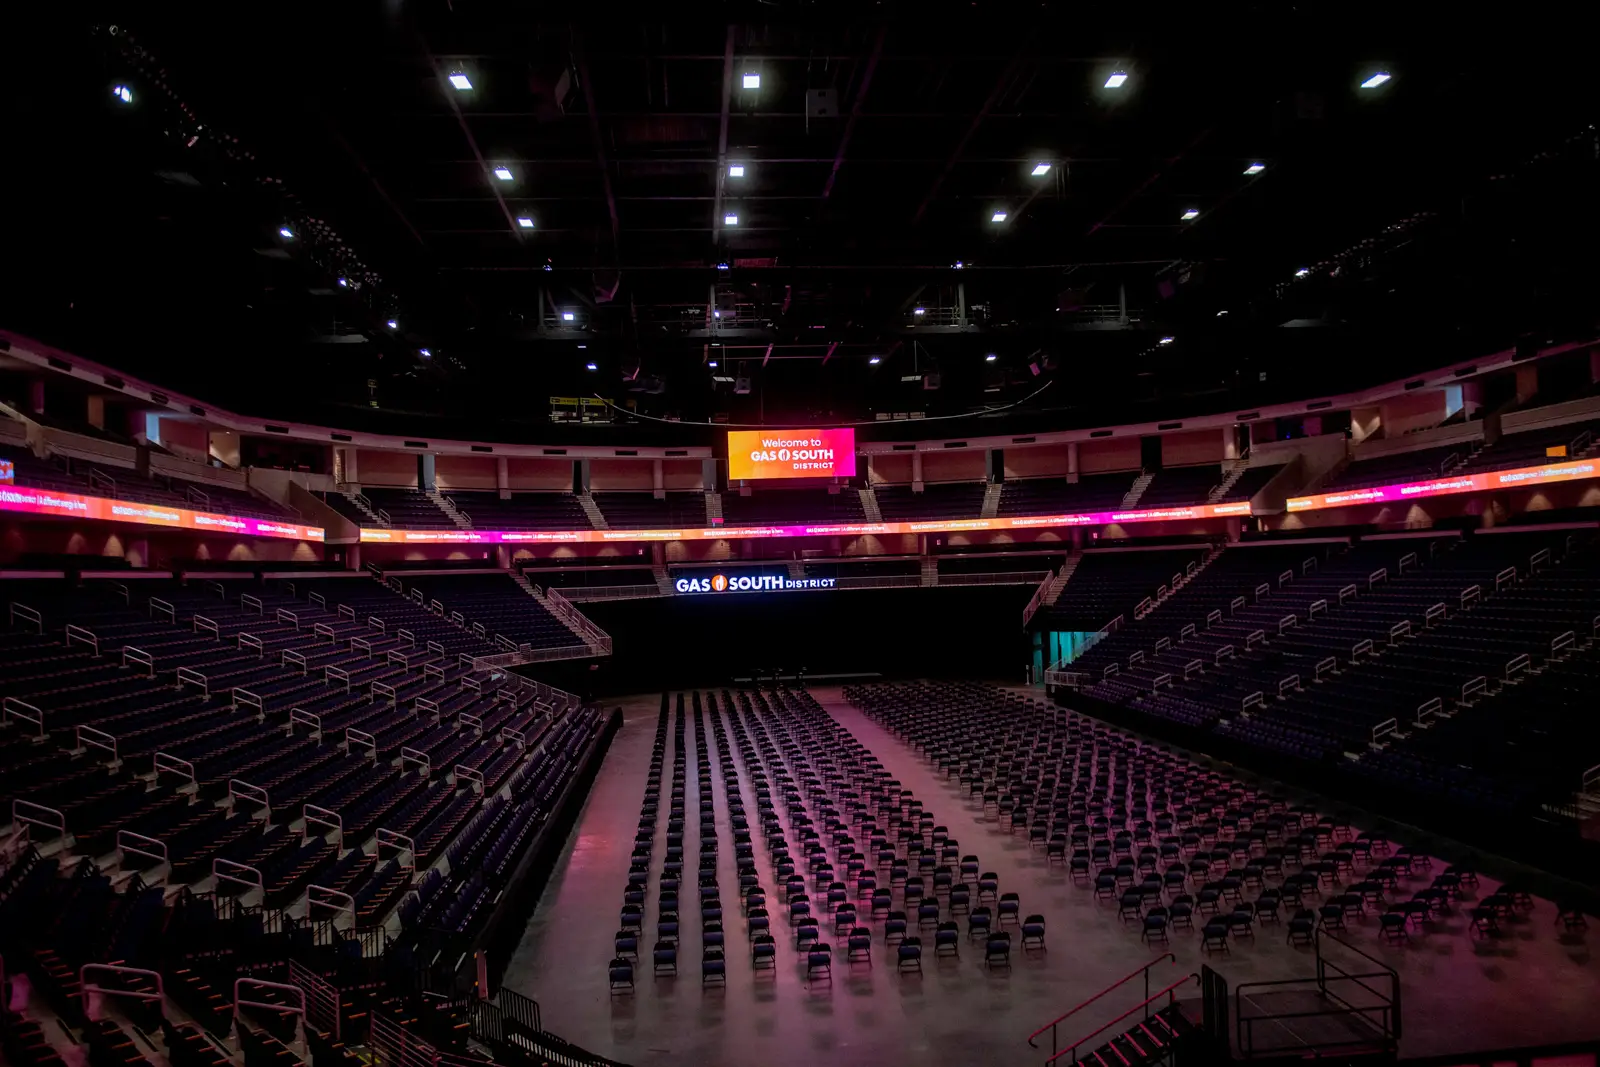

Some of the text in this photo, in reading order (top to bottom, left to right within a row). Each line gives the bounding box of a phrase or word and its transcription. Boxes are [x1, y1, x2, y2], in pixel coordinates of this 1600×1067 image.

[762, 438, 821, 447] Welcome to
[751, 449, 833, 461] GAS SOUTH
[676, 576, 835, 592] GAS SOUTH DISTRICT
